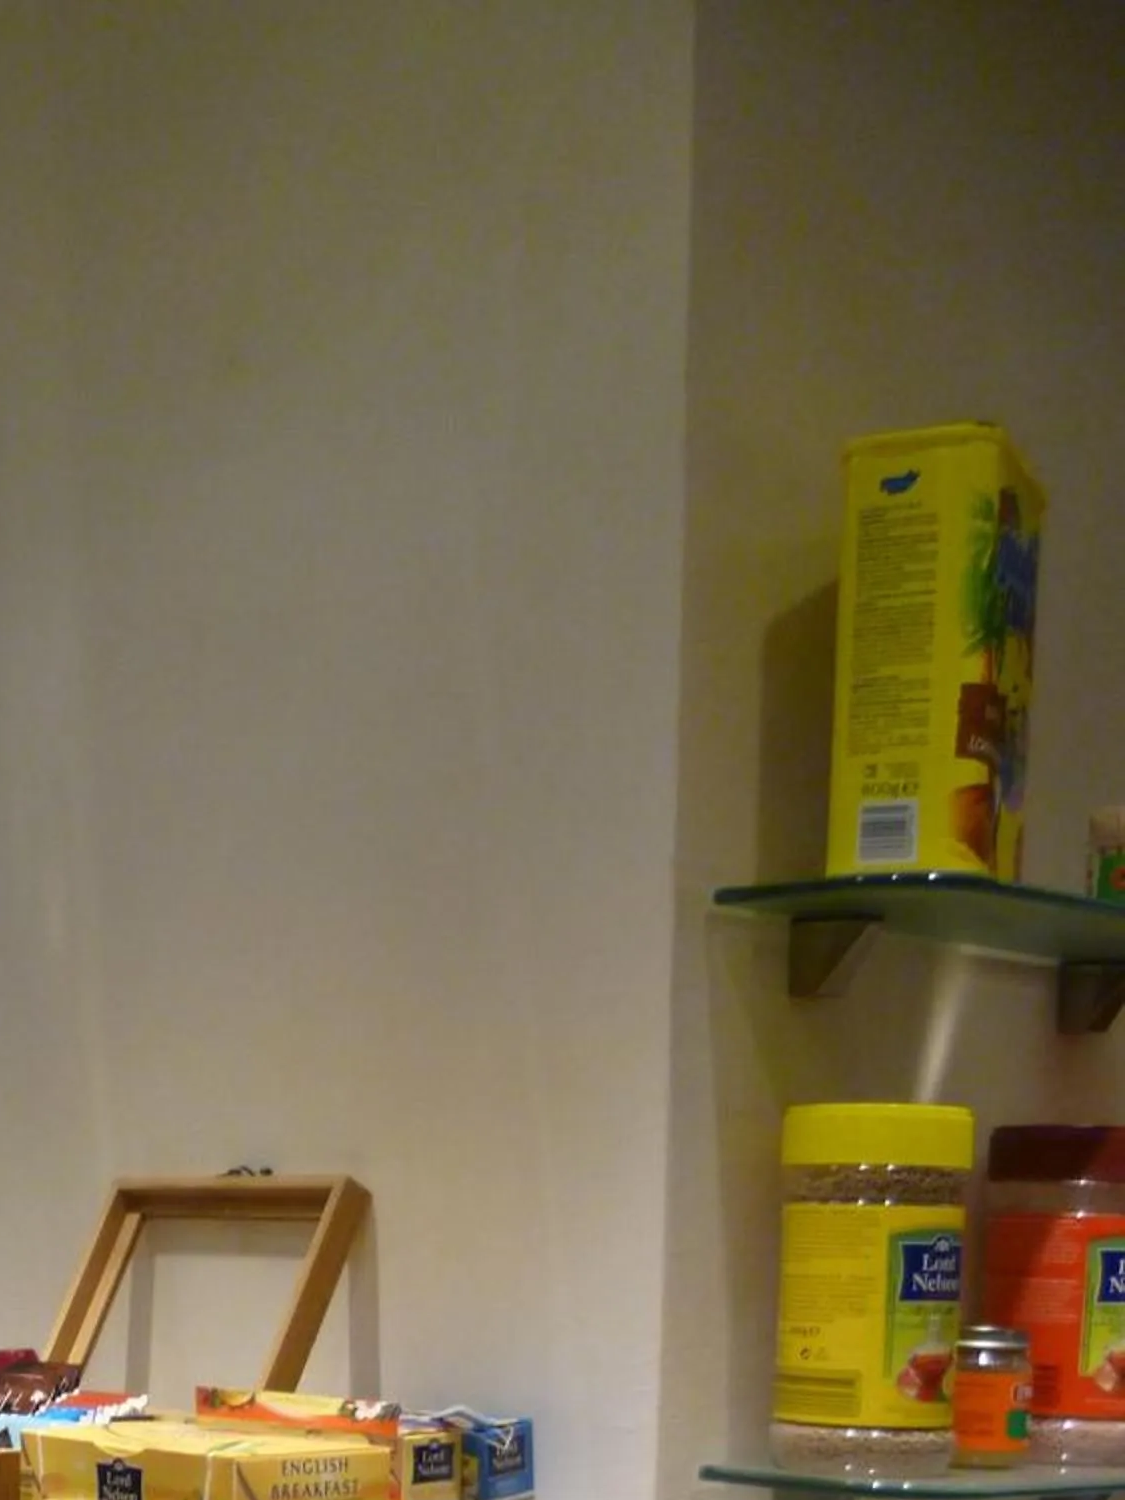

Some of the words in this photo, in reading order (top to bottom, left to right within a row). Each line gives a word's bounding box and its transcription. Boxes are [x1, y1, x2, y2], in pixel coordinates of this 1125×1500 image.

[281, 1457, 349, 1476] ENGLISH
[105, 1470, 134, 1488] Lord
[270, 1478, 359, 1500] BREAKFAST
